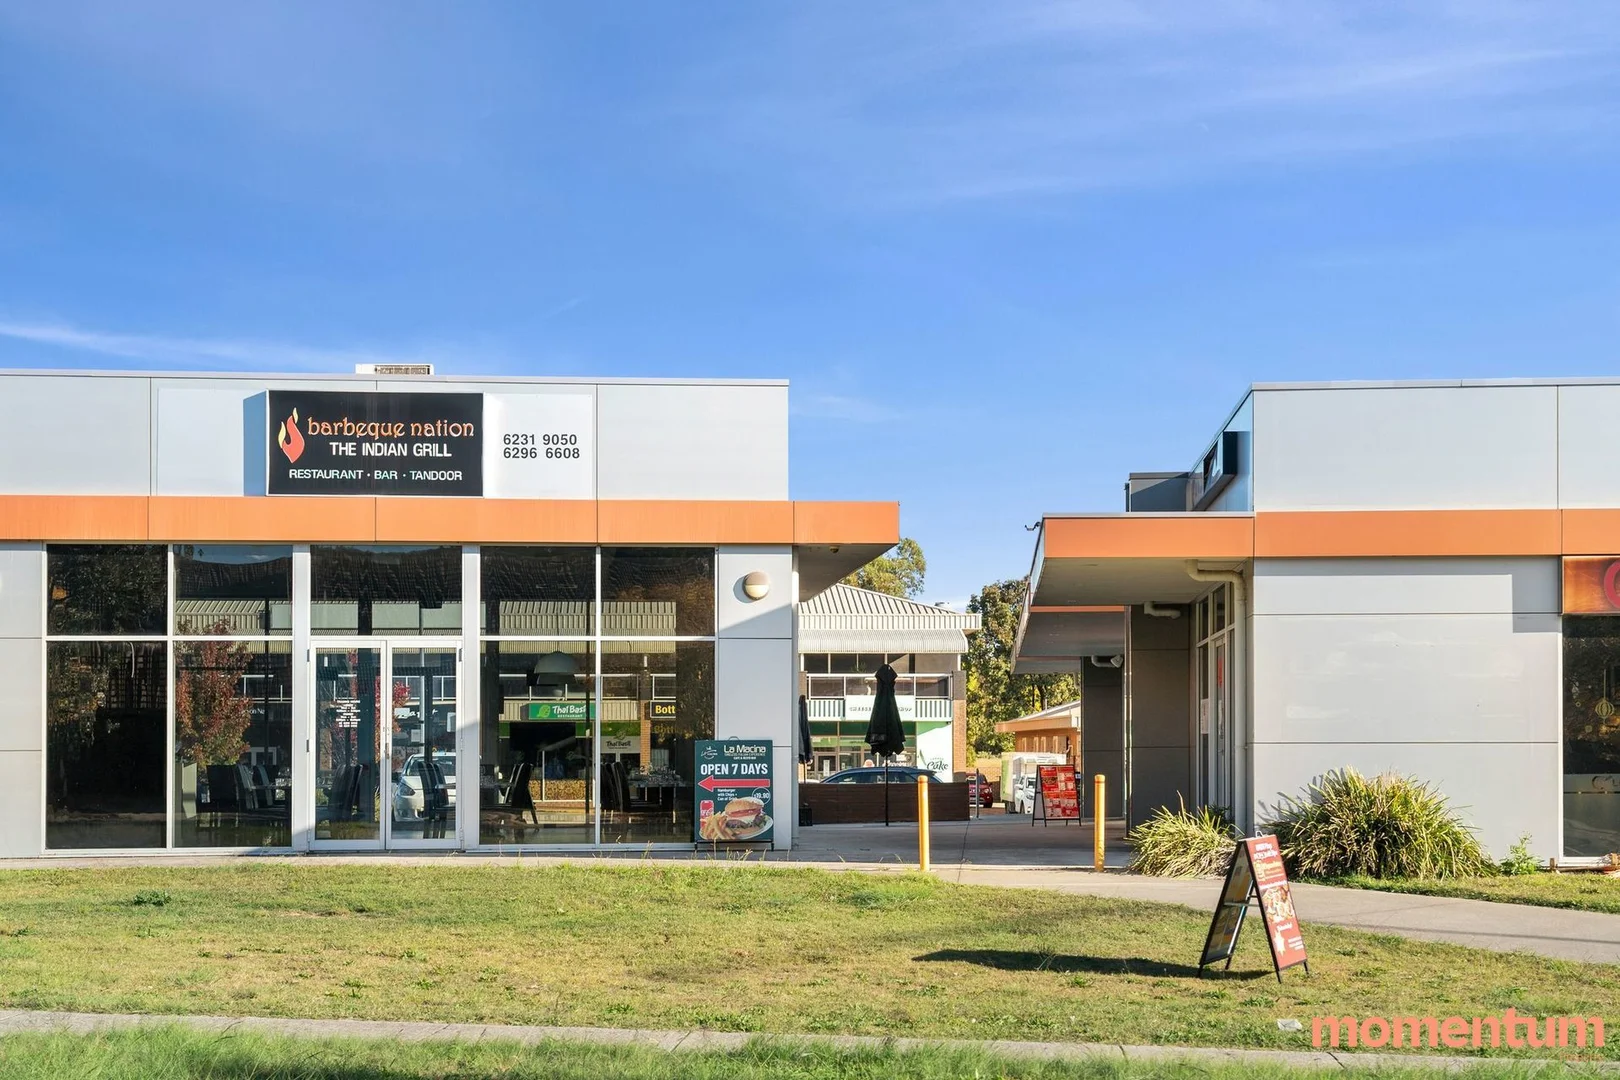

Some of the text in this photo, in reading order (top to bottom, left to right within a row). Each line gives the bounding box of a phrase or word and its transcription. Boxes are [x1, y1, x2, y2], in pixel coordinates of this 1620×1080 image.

[307, 417, 475, 440] barbeque nation
[503, 433, 577, 445] 6231 9050
[329, 442, 452, 457] THE INDIAN GRILL
[503, 446, 580, 459] 6296 6608
[289, 468, 463, 481] RESTAURANT BAR TANDOOR
[723, 744, 735, 753] La
[736, 744, 766, 753] Macina
[700, 763, 768, 775] OPEN 7 DAYS
